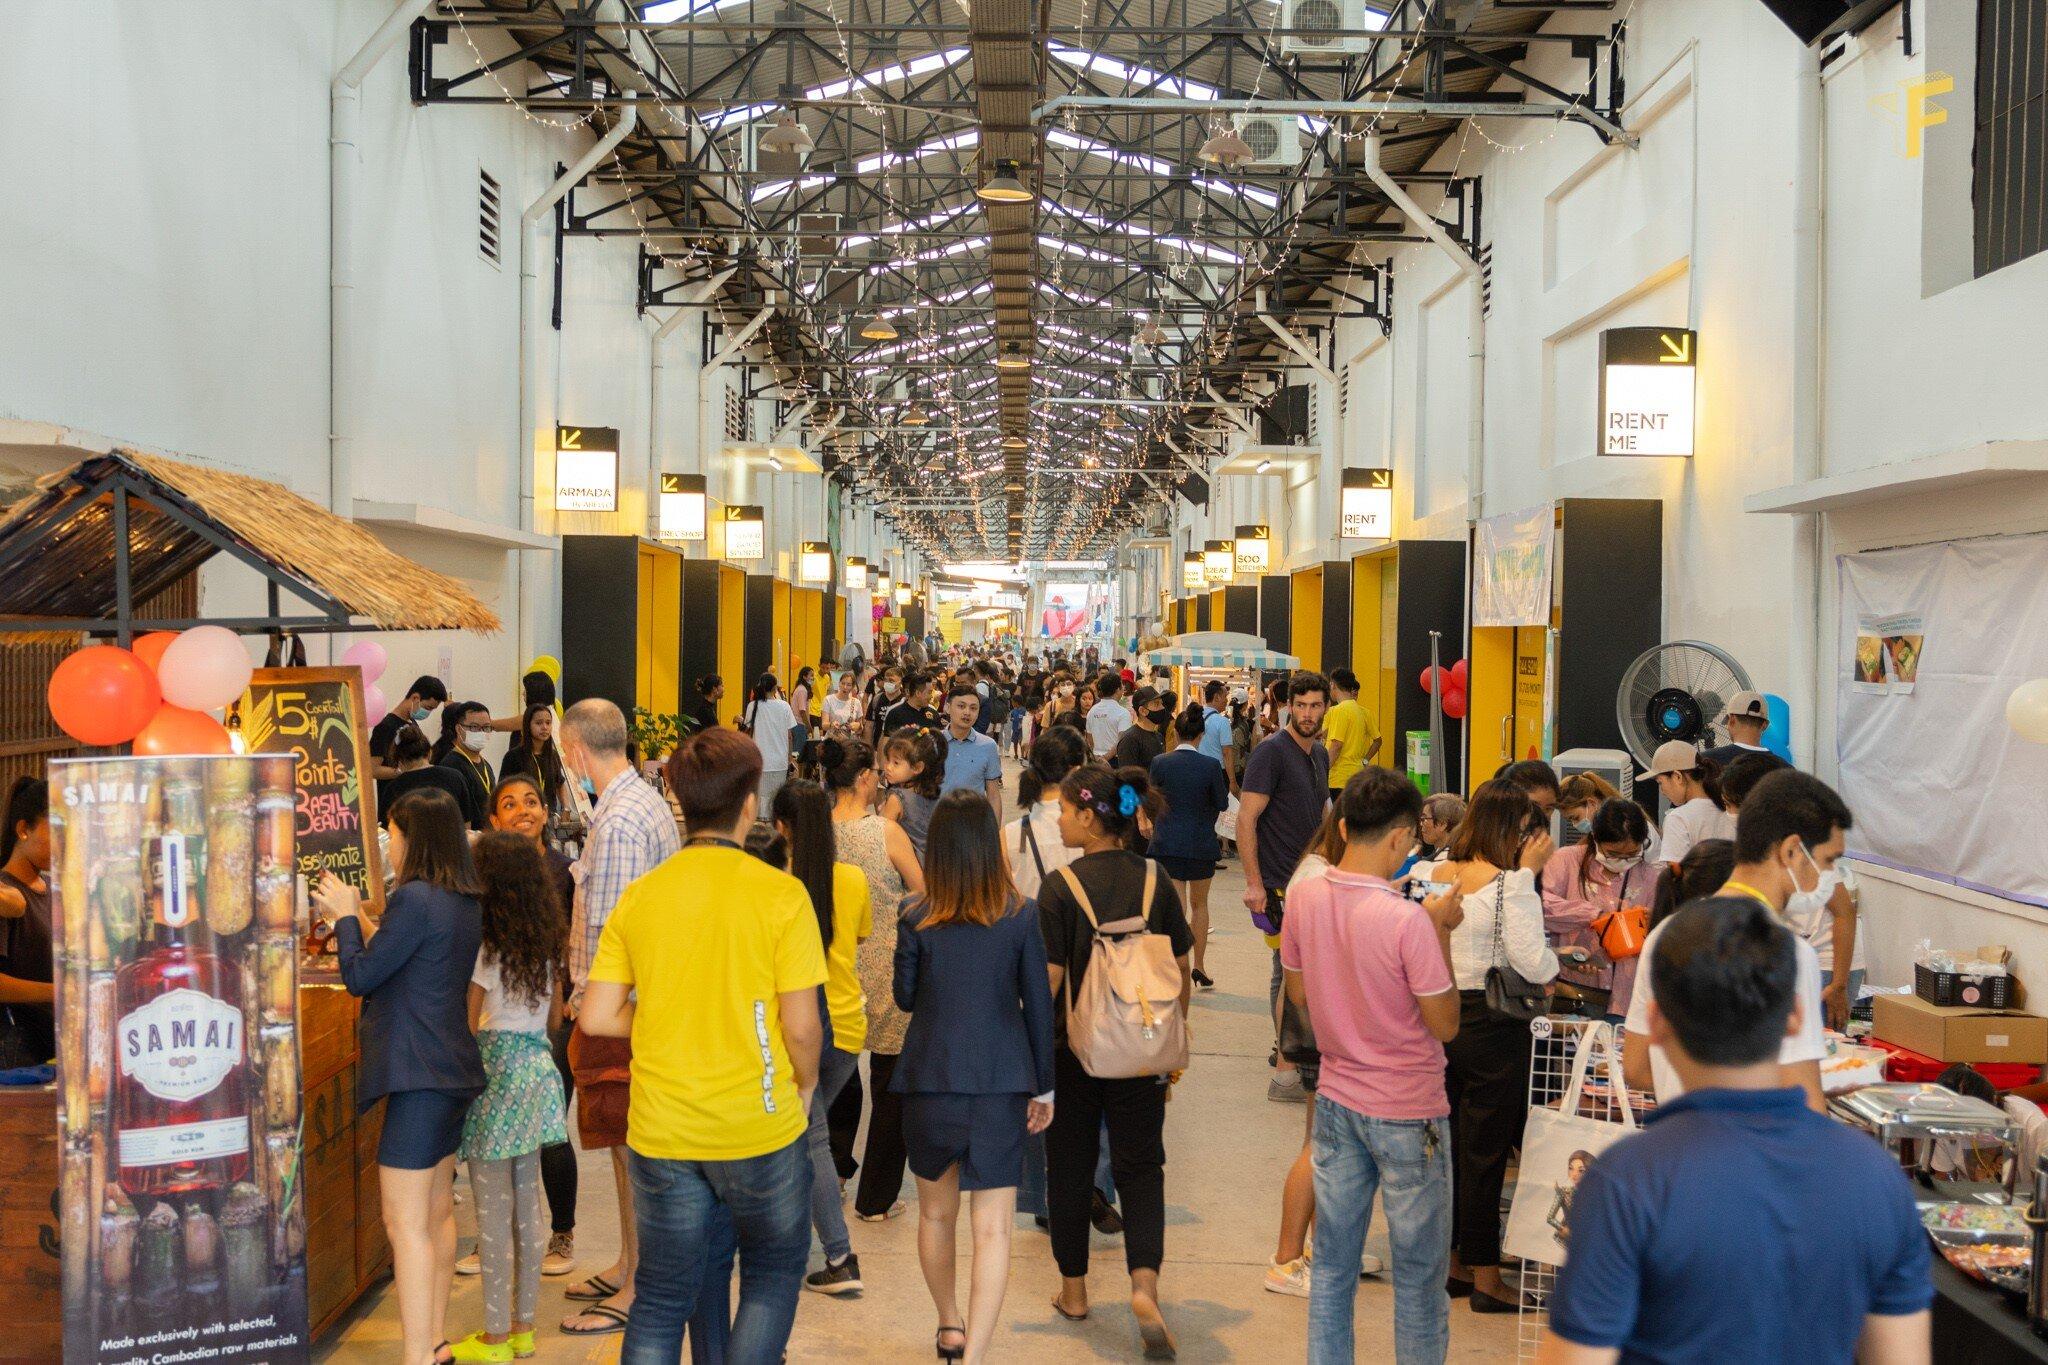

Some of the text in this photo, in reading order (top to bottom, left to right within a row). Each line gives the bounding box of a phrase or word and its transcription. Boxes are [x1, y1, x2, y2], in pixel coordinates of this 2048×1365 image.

[1609, 412, 1669, 430] RENT
[1609, 435, 1637, 450] ME
[559, 487, 612, 497] ARMADA
[1344, 514, 1377, 524] RENT
[1344, 526, 1360, 535] ME
[1237, 555, 1260, 563] SOO
[275, 692, 310, 736] 5
[63, 782, 149, 806] SAMAI
[1532, 1021, 1551, 1033] $10
[128, 1020, 234, 1057] SAMAI
[99, 1314, 277, 1351] Made exclusively with selected,
[151, 1346, 219, 1365] Cambodian
[221, 1343, 244, 1355] raw
[246, 1333, 298, 1351] materials
